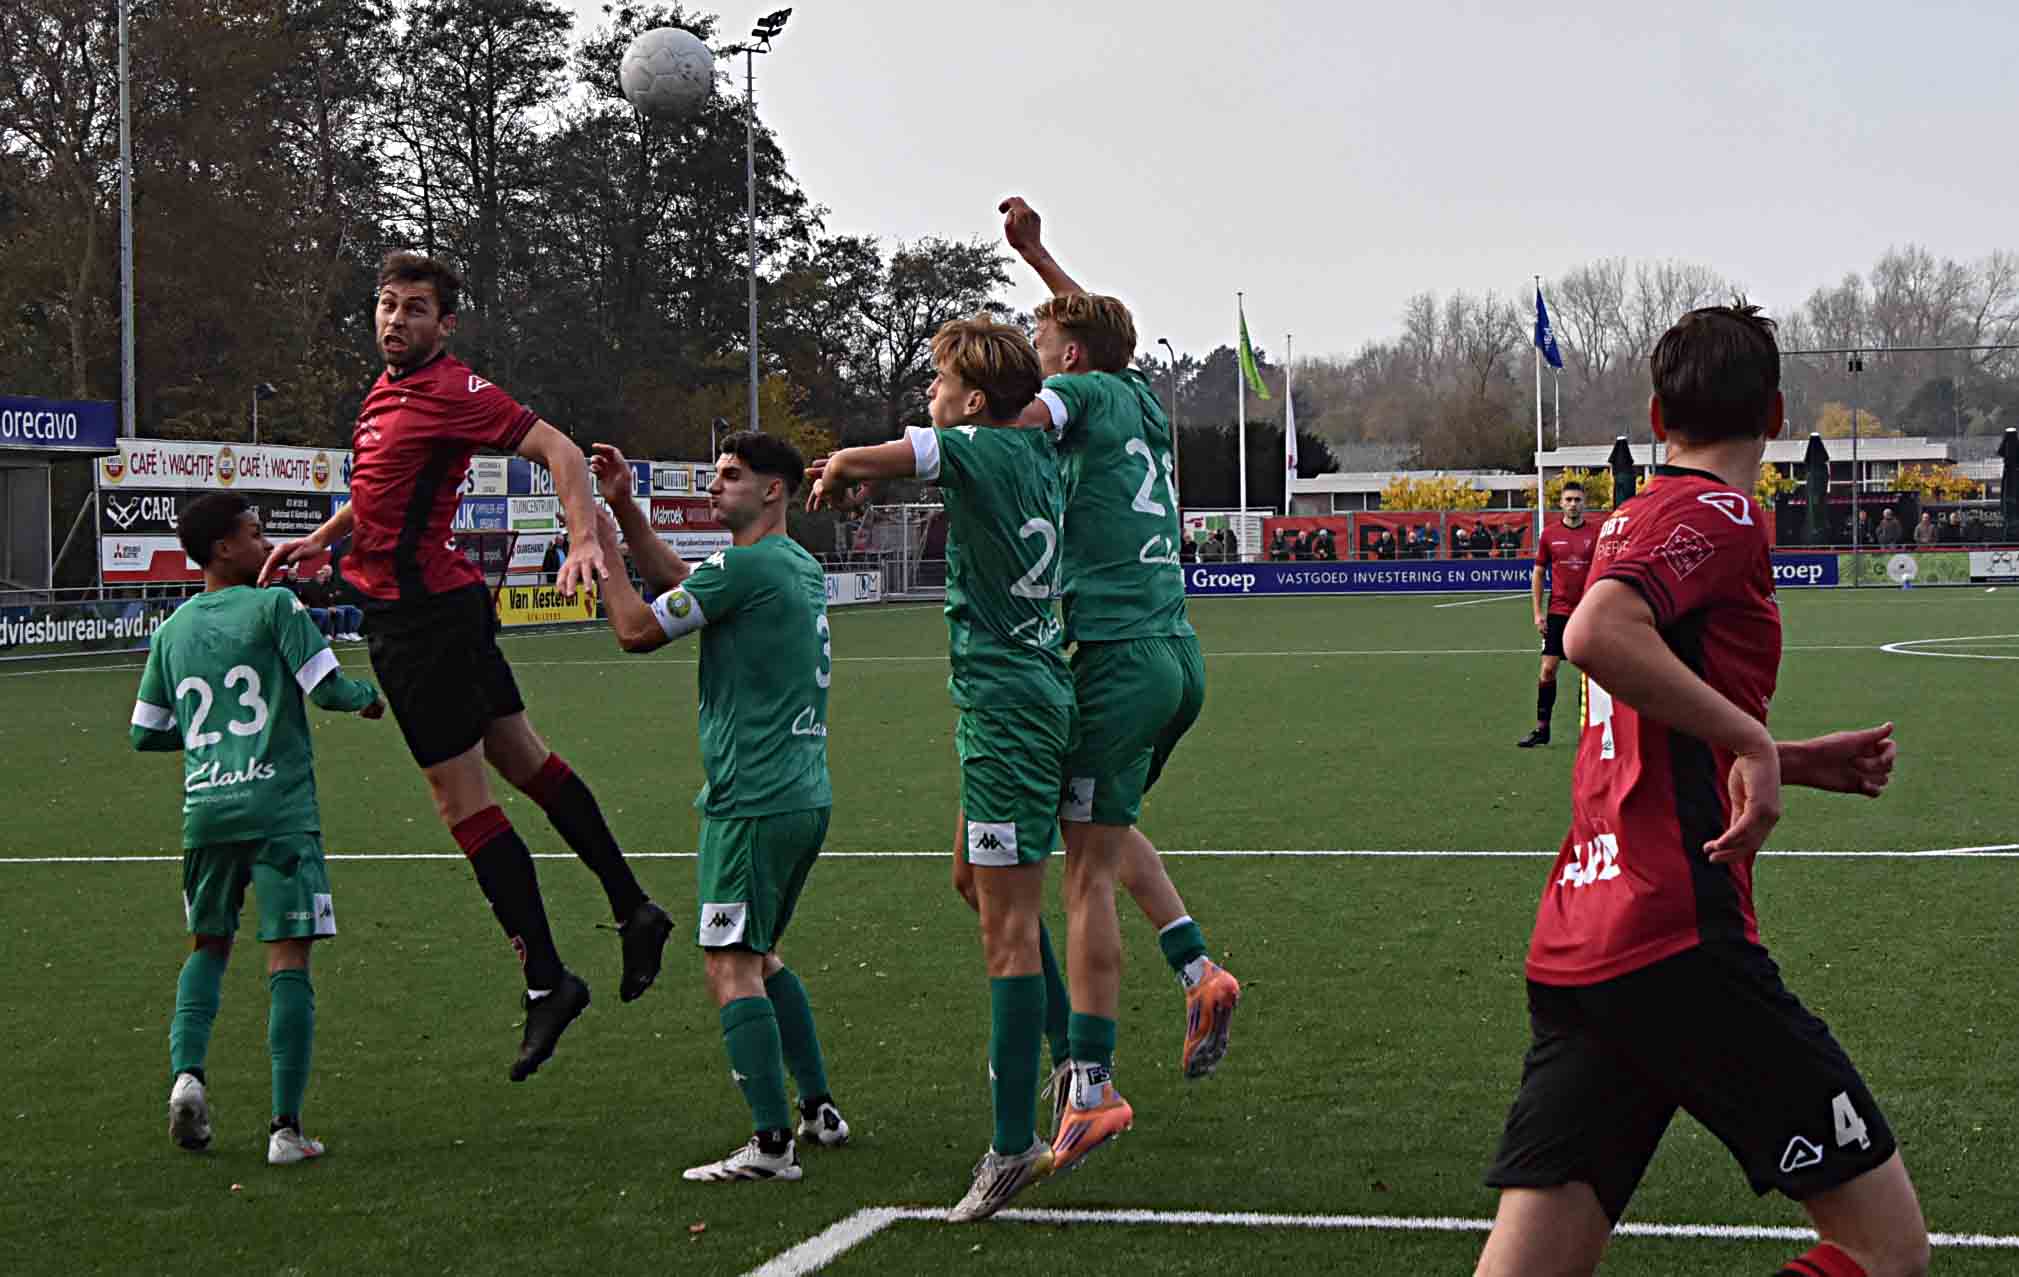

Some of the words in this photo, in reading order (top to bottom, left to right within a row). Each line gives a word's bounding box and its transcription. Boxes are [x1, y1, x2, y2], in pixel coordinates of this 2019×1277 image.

[1, 409, 77, 440] orecavo
[130, 448, 157, 475] CAFÉ
[168, 454, 214, 482] WACHTJE
[239, 452, 260, 477] CAFÉ
[270, 457, 310, 486] WACHTJE
[1192, 568, 1255, 592] Groep
[1276, 572, 1348, 585] VASTGOED
[1353, 570, 1442, 584] INVESTERING
[1448, 570, 1465, 584] EN
[1772, 565, 1823, 584] roep
[509, 588, 529, 609] Van
[176, 664, 268, 750] 23
[185, 757, 276, 792] Clarks
[1831, 1091, 1871, 1150] 4
